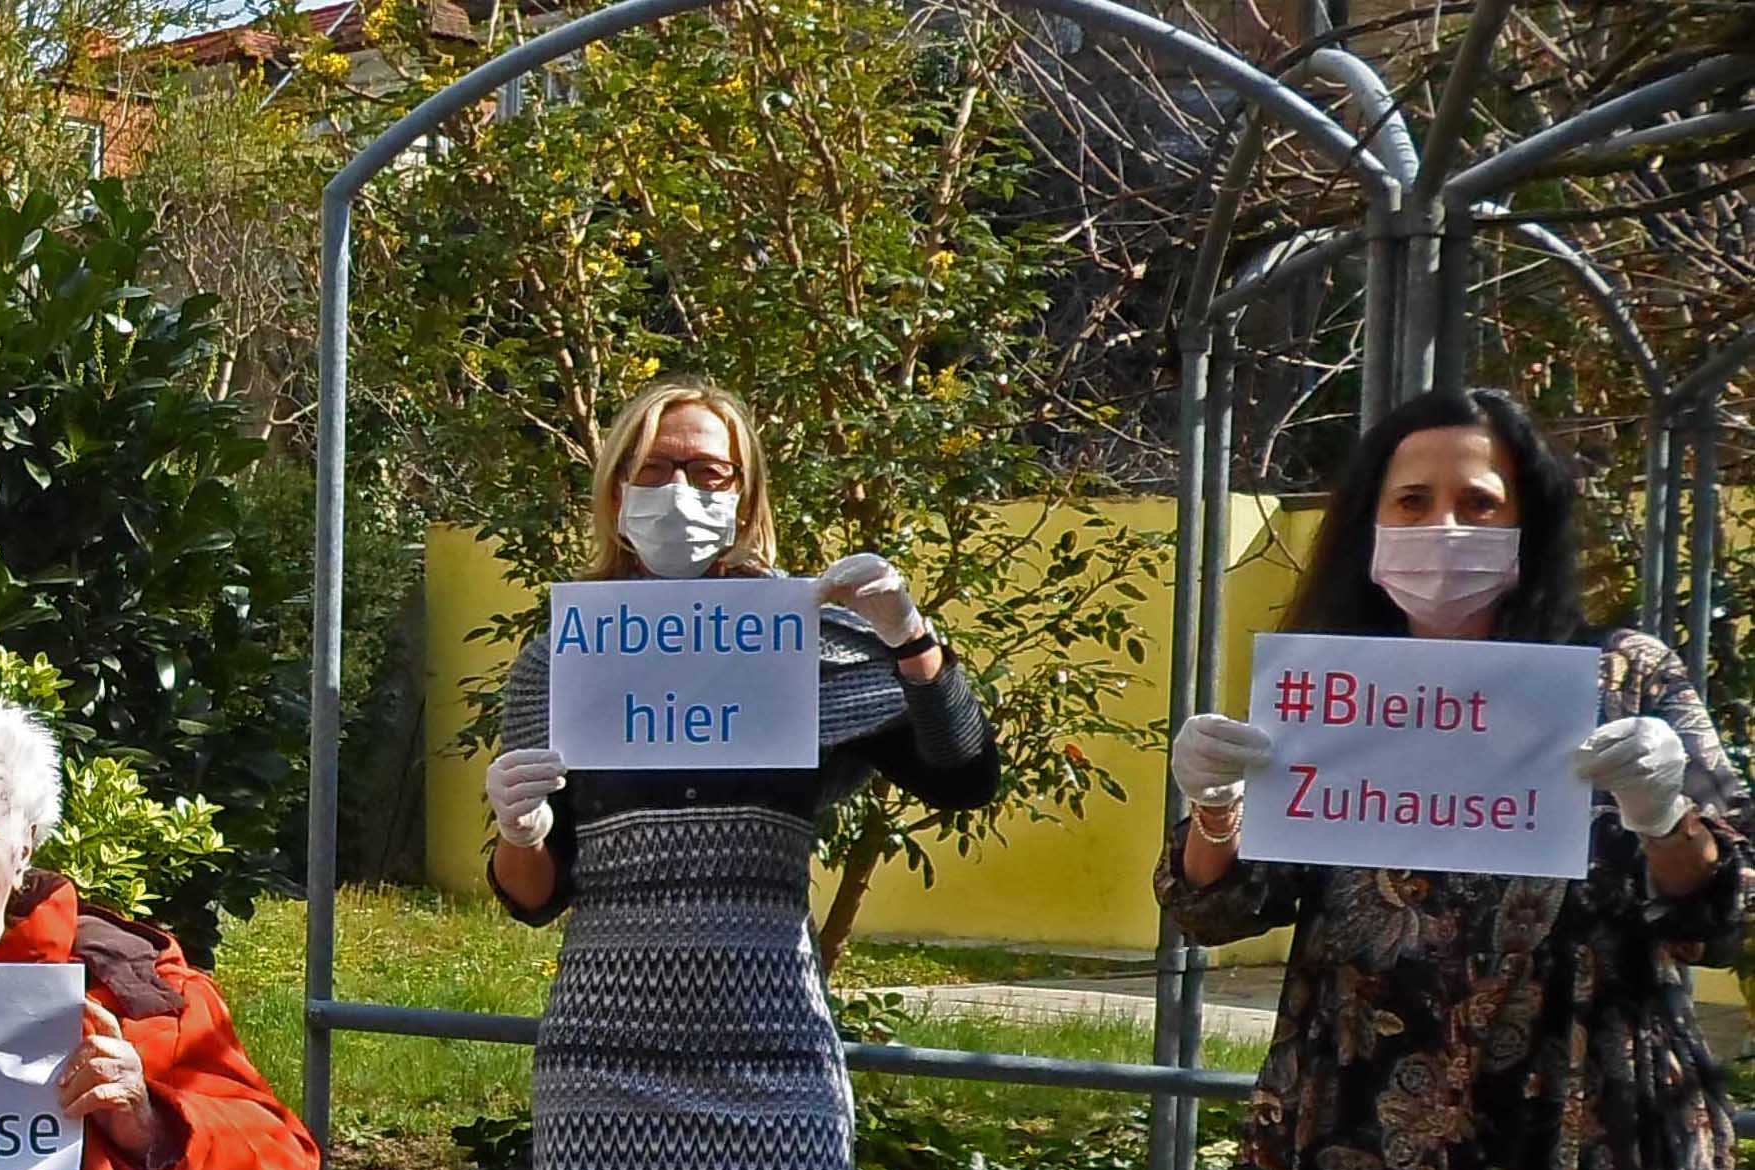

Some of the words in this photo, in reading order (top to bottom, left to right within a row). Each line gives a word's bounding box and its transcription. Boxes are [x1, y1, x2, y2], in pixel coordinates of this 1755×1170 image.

[555, 602, 804, 655] Arbeiten
[624, 692, 739, 744] hier
[1274, 670, 1488, 733] #Bleibt
[1284, 765, 1539, 831] Zuhause!
